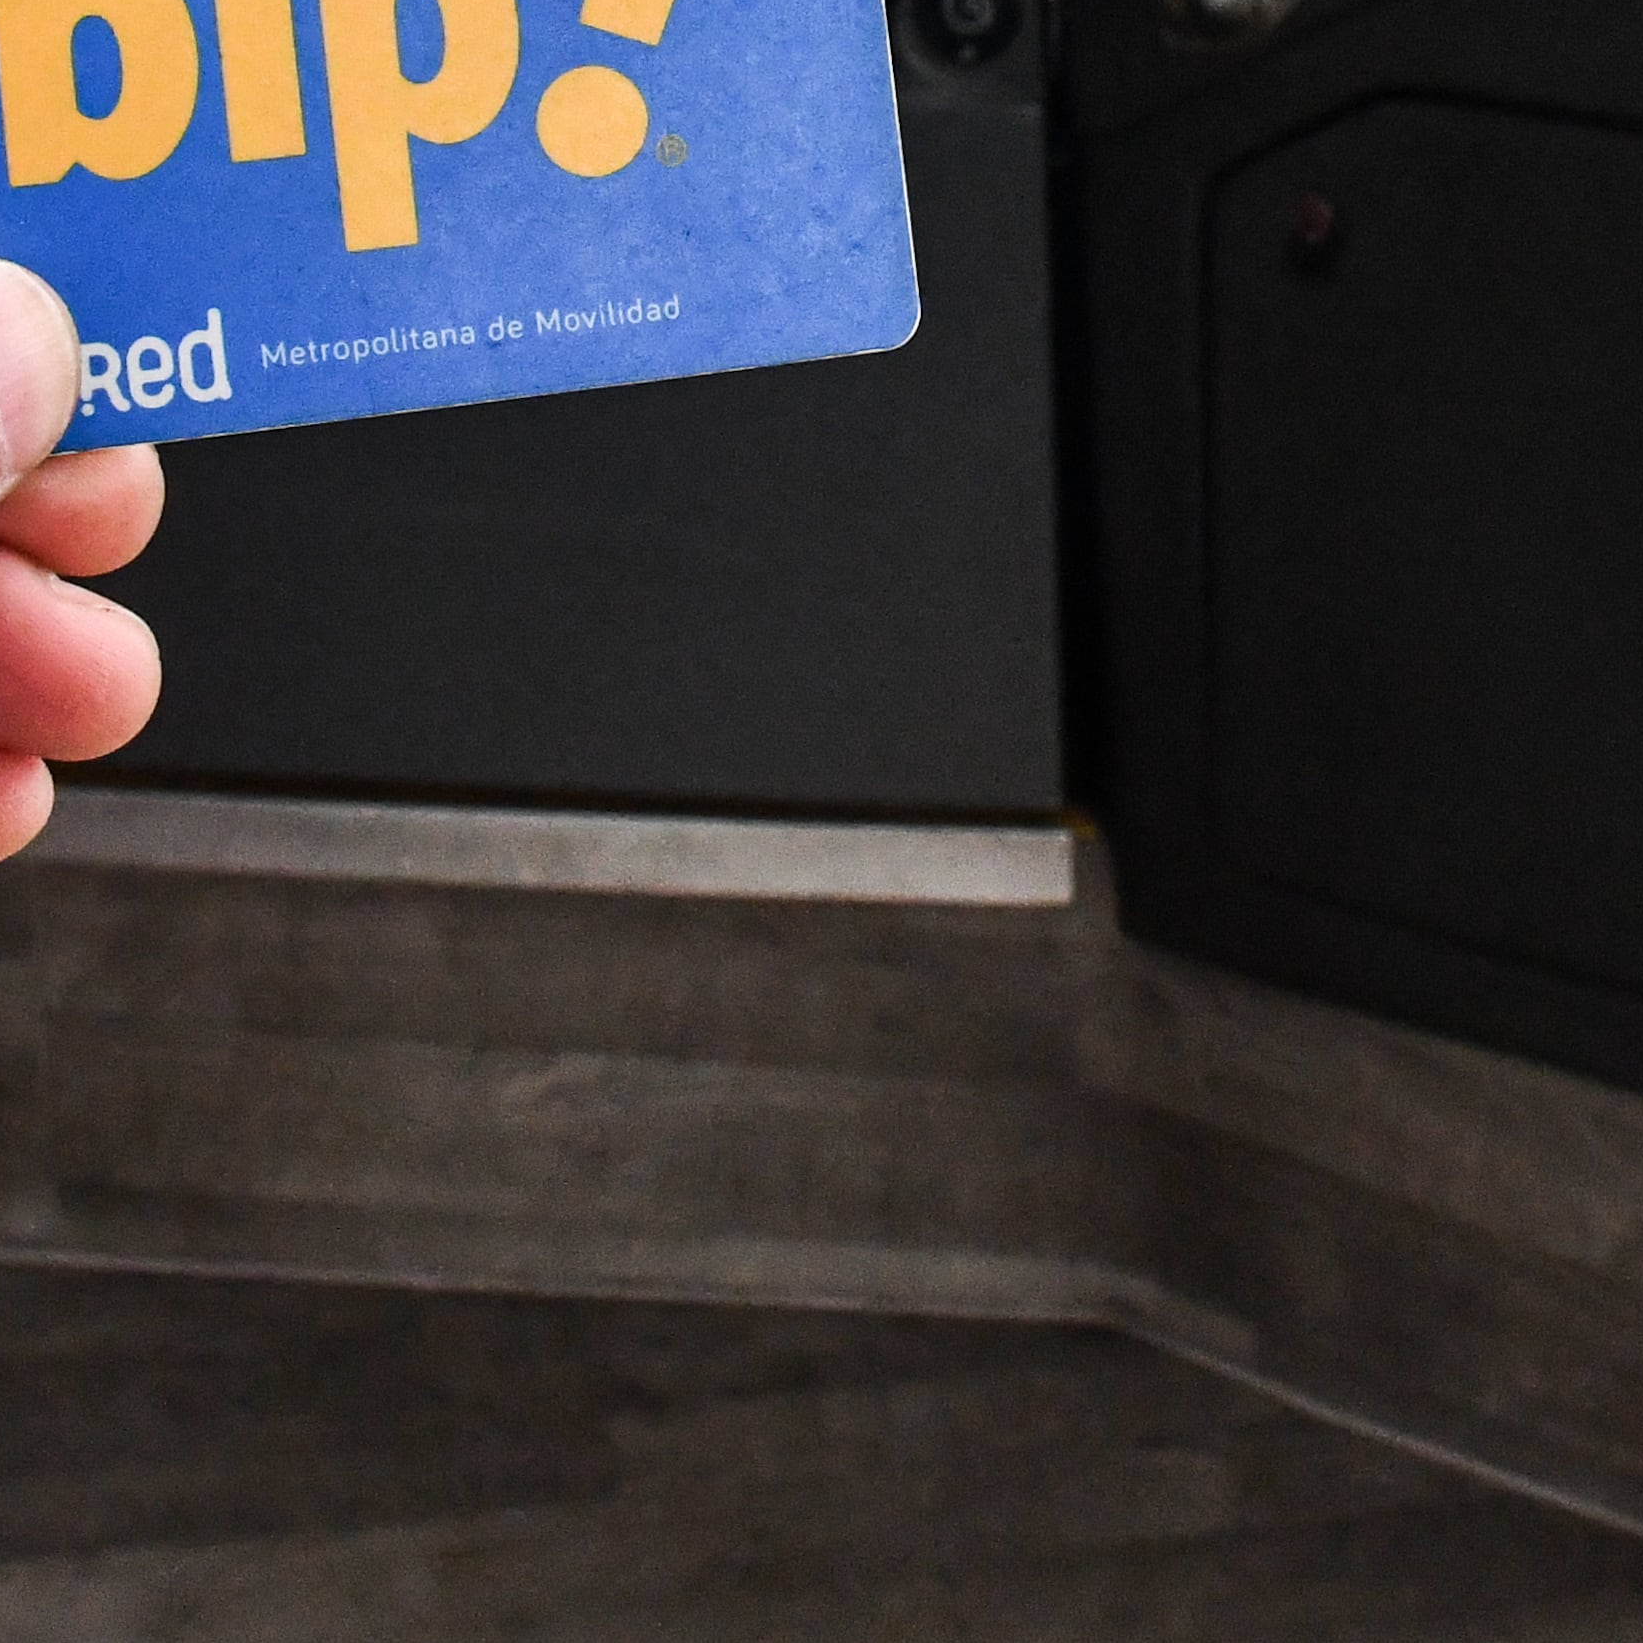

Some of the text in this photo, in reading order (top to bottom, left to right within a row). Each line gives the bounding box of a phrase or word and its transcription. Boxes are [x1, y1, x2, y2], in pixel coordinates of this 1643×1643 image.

[80, 295, 681, 416] Red Metropolitana de Movilidad
